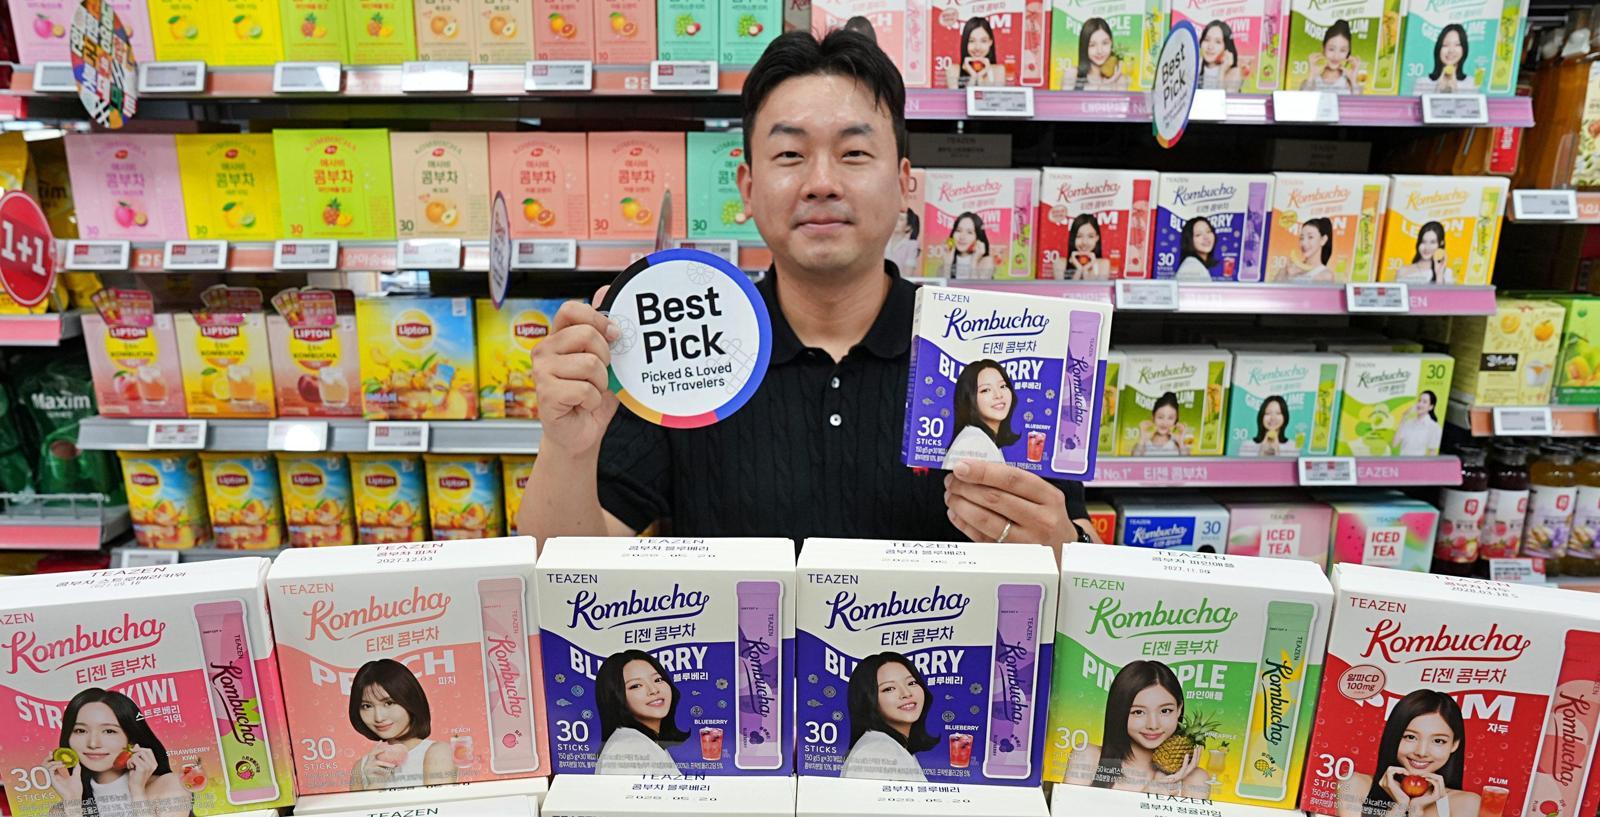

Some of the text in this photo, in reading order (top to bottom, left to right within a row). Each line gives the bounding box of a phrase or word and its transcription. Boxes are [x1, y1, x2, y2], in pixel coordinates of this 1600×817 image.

[935, 56, 951, 70] 30
[1162, 42, 1186, 85] Best
[1163, 69, 1186, 109] Pick
[106, 173, 145, 188] 콤부차
[216, 172, 255, 188] 콤부차
[314, 170, 353, 185] 콤부차
[422, 170, 458, 185] 콤부차
[520, 171, 556, 184] 콤부차
[619, 170, 656, 184] 콤부차
[939, 180, 1002, 201] Kombucha
[1057, 180, 1121, 203] Kombucha
[1173, 184, 1237, 205] Kombucha
[1289, 187, 1351, 208] Kombucha
[290, 224, 303, 235] 30
[399, 220, 414, 231] 30
[594, 219, 609, 231] 30
[692, 220, 707, 231] 30
[1, 221, 47, 276] 1+1
[1043, 251, 1058, 263] 30
[1157, 253, 1175, 266] 30
[933, 293, 970, 303] TEAZEN
[636, 286, 722, 326] Best
[201, 326, 238, 336] LIPTON
[398, 325, 429, 336] Lipton
[516, 325, 547, 336] Lipton
[942, 308, 1050, 341] Kombucha
[294, 328, 331, 339] LIPTON
[643, 324, 726, 364] Pick
[983, 340, 1037, 354] 티젠 콤부차
[641, 362, 732, 383] Picked & Loved
[1138, 364, 1197, 384] Kombucha
[1248, 364, 1309, 386] Kombucha
[1358, 370, 1410, 388] Kombucha
[1426, 364, 1446, 380] 30
[652, 377, 725, 397] by Travelers
[1069, 356, 1089, 427] Kombucha
[31, 392, 91, 410] Maxim
[917, 416, 944, 437] 30
[916, 438, 942, 446] STICKS
[218, 476, 250, 486] Lipton
[292, 475, 322, 486] Lipton
[366, 476, 396, 486] Lipton
[1143, 467, 1208, 481] 티젠 콤부차
[439, 477, 469, 488] Lipton
[1132, 526, 1187, 544] Kombucha
[1202, 520, 1221, 535] 30
[1267, 529, 1295, 541] ICED
[1371, 532, 1400, 543] ICED
[375, 543, 444, 551] TEAZEN
[1268, 544, 1291, 556] TEA
[1372, 545, 1395, 557] TEA
[92, 567, 166, 578] TEAZEN
[547, 573, 598, 584] TEAZEN
[807, 573, 859, 585] TEAZEN
[280, 583, 334, 595] TEAZEN
[1072, 577, 1125, 591] TEAZEN
[567, 583, 710, 631] Kombucha
[824, 585, 970, 632] Kombucha
[1350, 597, 1406, 614] TEAZEN
[303, 586, 451, 642] Kombucha
[1085, 597, 1238, 639] Kombucha
[624, 623, 696, 644] 티젠 콤부차
[881, 626, 954, 646] 티젠 콤부차
[1026, 617, 1034, 641] TEAZEN
[1, 613, 166, 674] Kombucha
[235, 634, 243, 659] TEAZEN
[366, 626, 440, 653] 티젠 콤부차
[1360, 618, 1530, 664] Kombucha
[1142, 639, 1220, 656] 티젠 콤부차
[1294, 637, 1303, 661] TEAZEN
[76, 653, 156, 684] 티젠 콤부차
[570, 646, 708, 681] BLRRY
[825, 647, 965, 683] BLRRY
[310, 649, 456, 696] PECH
[488, 635, 526, 718] Kombucha
[673, 672, 709, 682] 블루베리
[743, 636, 775, 718] Kombucha
[1082, 652, 1228, 692] PINPLE
[1347, 673, 1379, 683] 알파CD
[1420, 667, 1507, 684] 티젠 콤부차
[438, 675, 456, 685] 피치
[928, 676, 963, 686] 블루베리
[998, 641, 1028, 725] Kombucha
[1347, 682, 1375, 691] 100mg
[1185, 690, 1224, 701] 파인애플
[1262, 658, 1293, 746] Kombucha
[211, 661, 259, 747] Kombucha
[136, 705, 180, 721] 스트로베리
[164, 713, 182, 723] 키위
[451, 726, 471, 734] PEACH
[556, 720, 589, 742] 30
[804, 721, 838, 744] 30
[1204, 731, 1238, 740] PINEAPPLE
[1487, 723, 1509, 734] 자두
[1055, 727, 1088, 750] 30
[1554, 691, 1590, 787] Kombucha
[166, 747, 210, 757] STRAWBERRY
[302, 738, 336, 761] 30
[557, 743, 590, 752] STICKS
[804, 745, 837, 754] STICKS
[303, 762, 338, 771] STICKS
[1316, 754, 1354, 780] 30
[11, 767, 51, 792] 30
[642, 771, 706, 781] TEAZEN
[1488, 777, 1508, 785] PLUM
[882, 785, 913, 793] 콤부차
[1313, 778, 1350, 791] STICKS
[16, 793, 56, 803] STICKS
[1140, 802, 1173, 812] 콤부차
